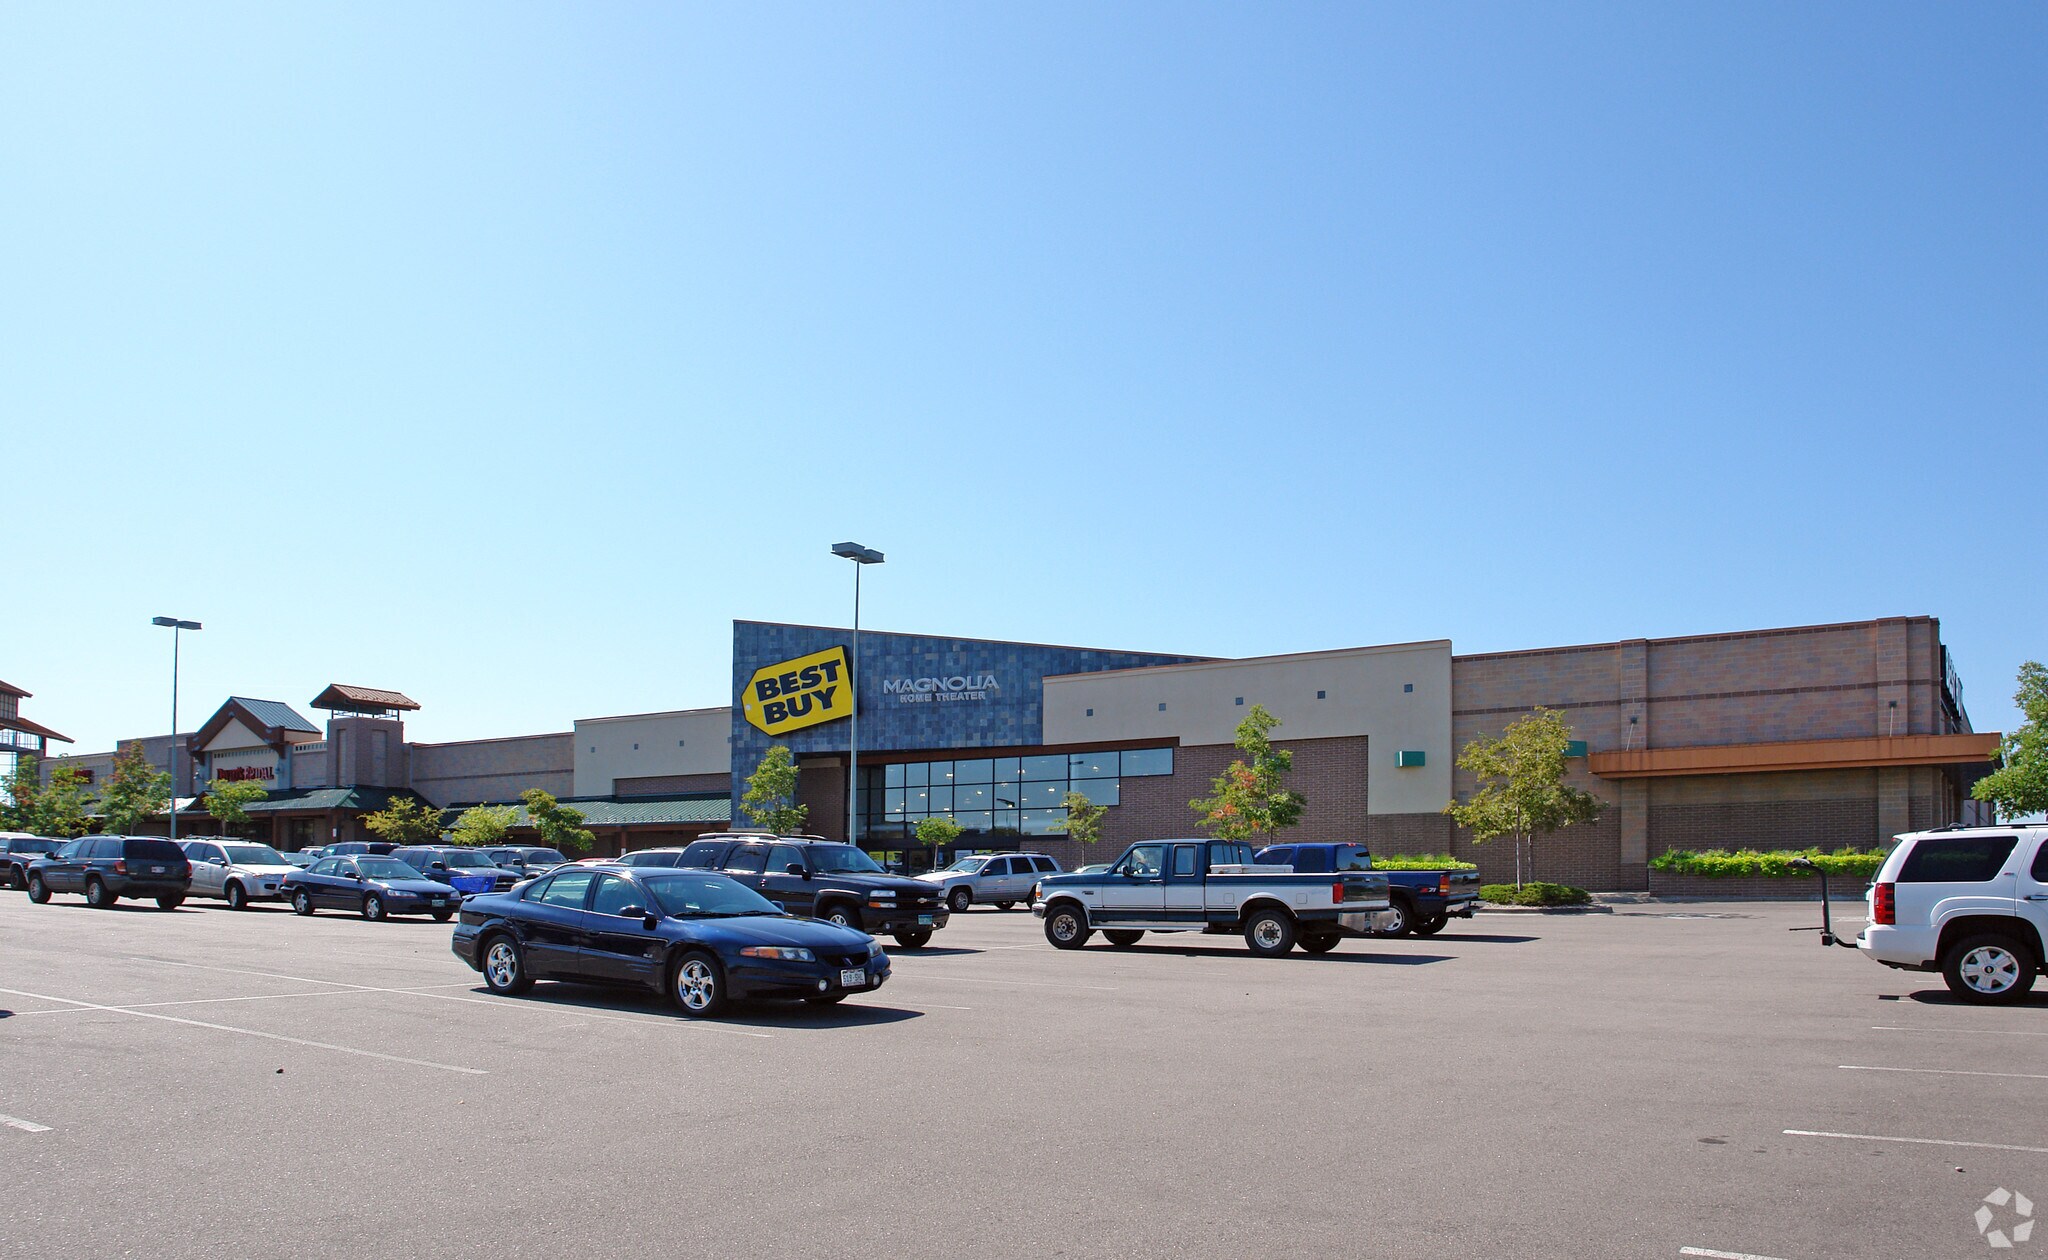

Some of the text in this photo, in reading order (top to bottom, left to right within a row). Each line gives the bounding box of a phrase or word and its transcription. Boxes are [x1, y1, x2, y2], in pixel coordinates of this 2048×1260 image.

[755, 659, 841, 702] BEST
[883, 675, 1000, 694] MAGNOLIA
[763, 685, 837, 725] BUY
[900, 691, 986, 703] HOME THEATER
